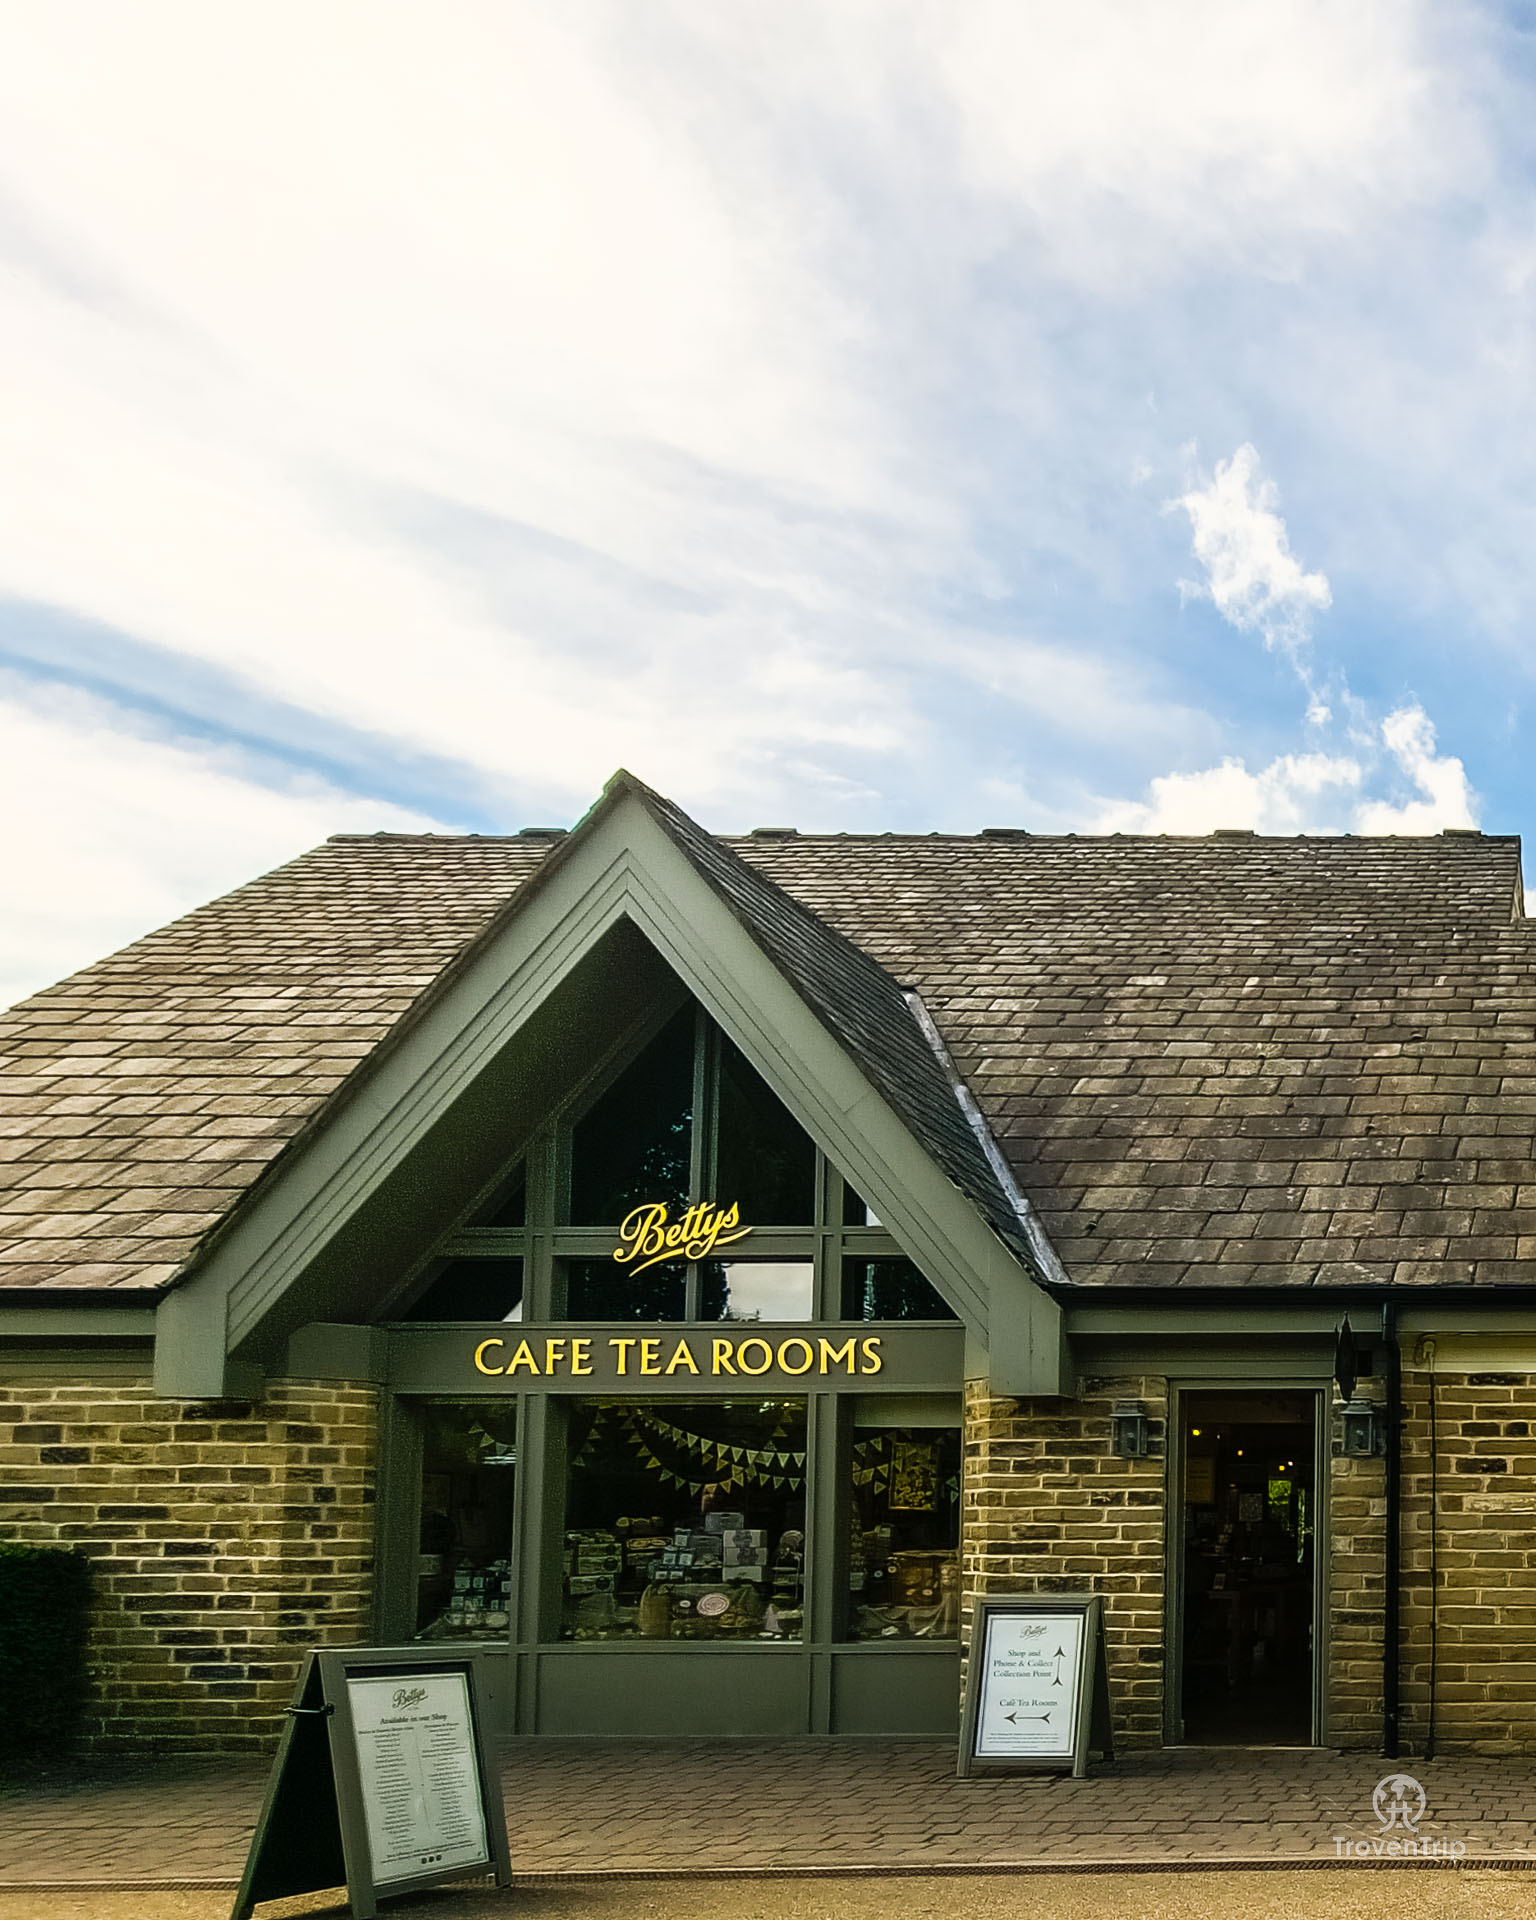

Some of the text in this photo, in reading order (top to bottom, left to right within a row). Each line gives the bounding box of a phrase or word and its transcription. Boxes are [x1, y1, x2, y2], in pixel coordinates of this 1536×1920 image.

[612, 1200, 753, 1277] Bettys
[474, 1337, 883, 1376] CAFE TEA ROOMS
[1019, 1625, 1049, 1640] Bettys
[1008, 1649, 1026, 1657] Shop
[392, 1688, 428, 1709] Bettys
[1017, 1699, 1030, 1707] Tea
[1031, 1699, 1058, 1707] Rooms
[380, 1716, 409, 1724] Available
